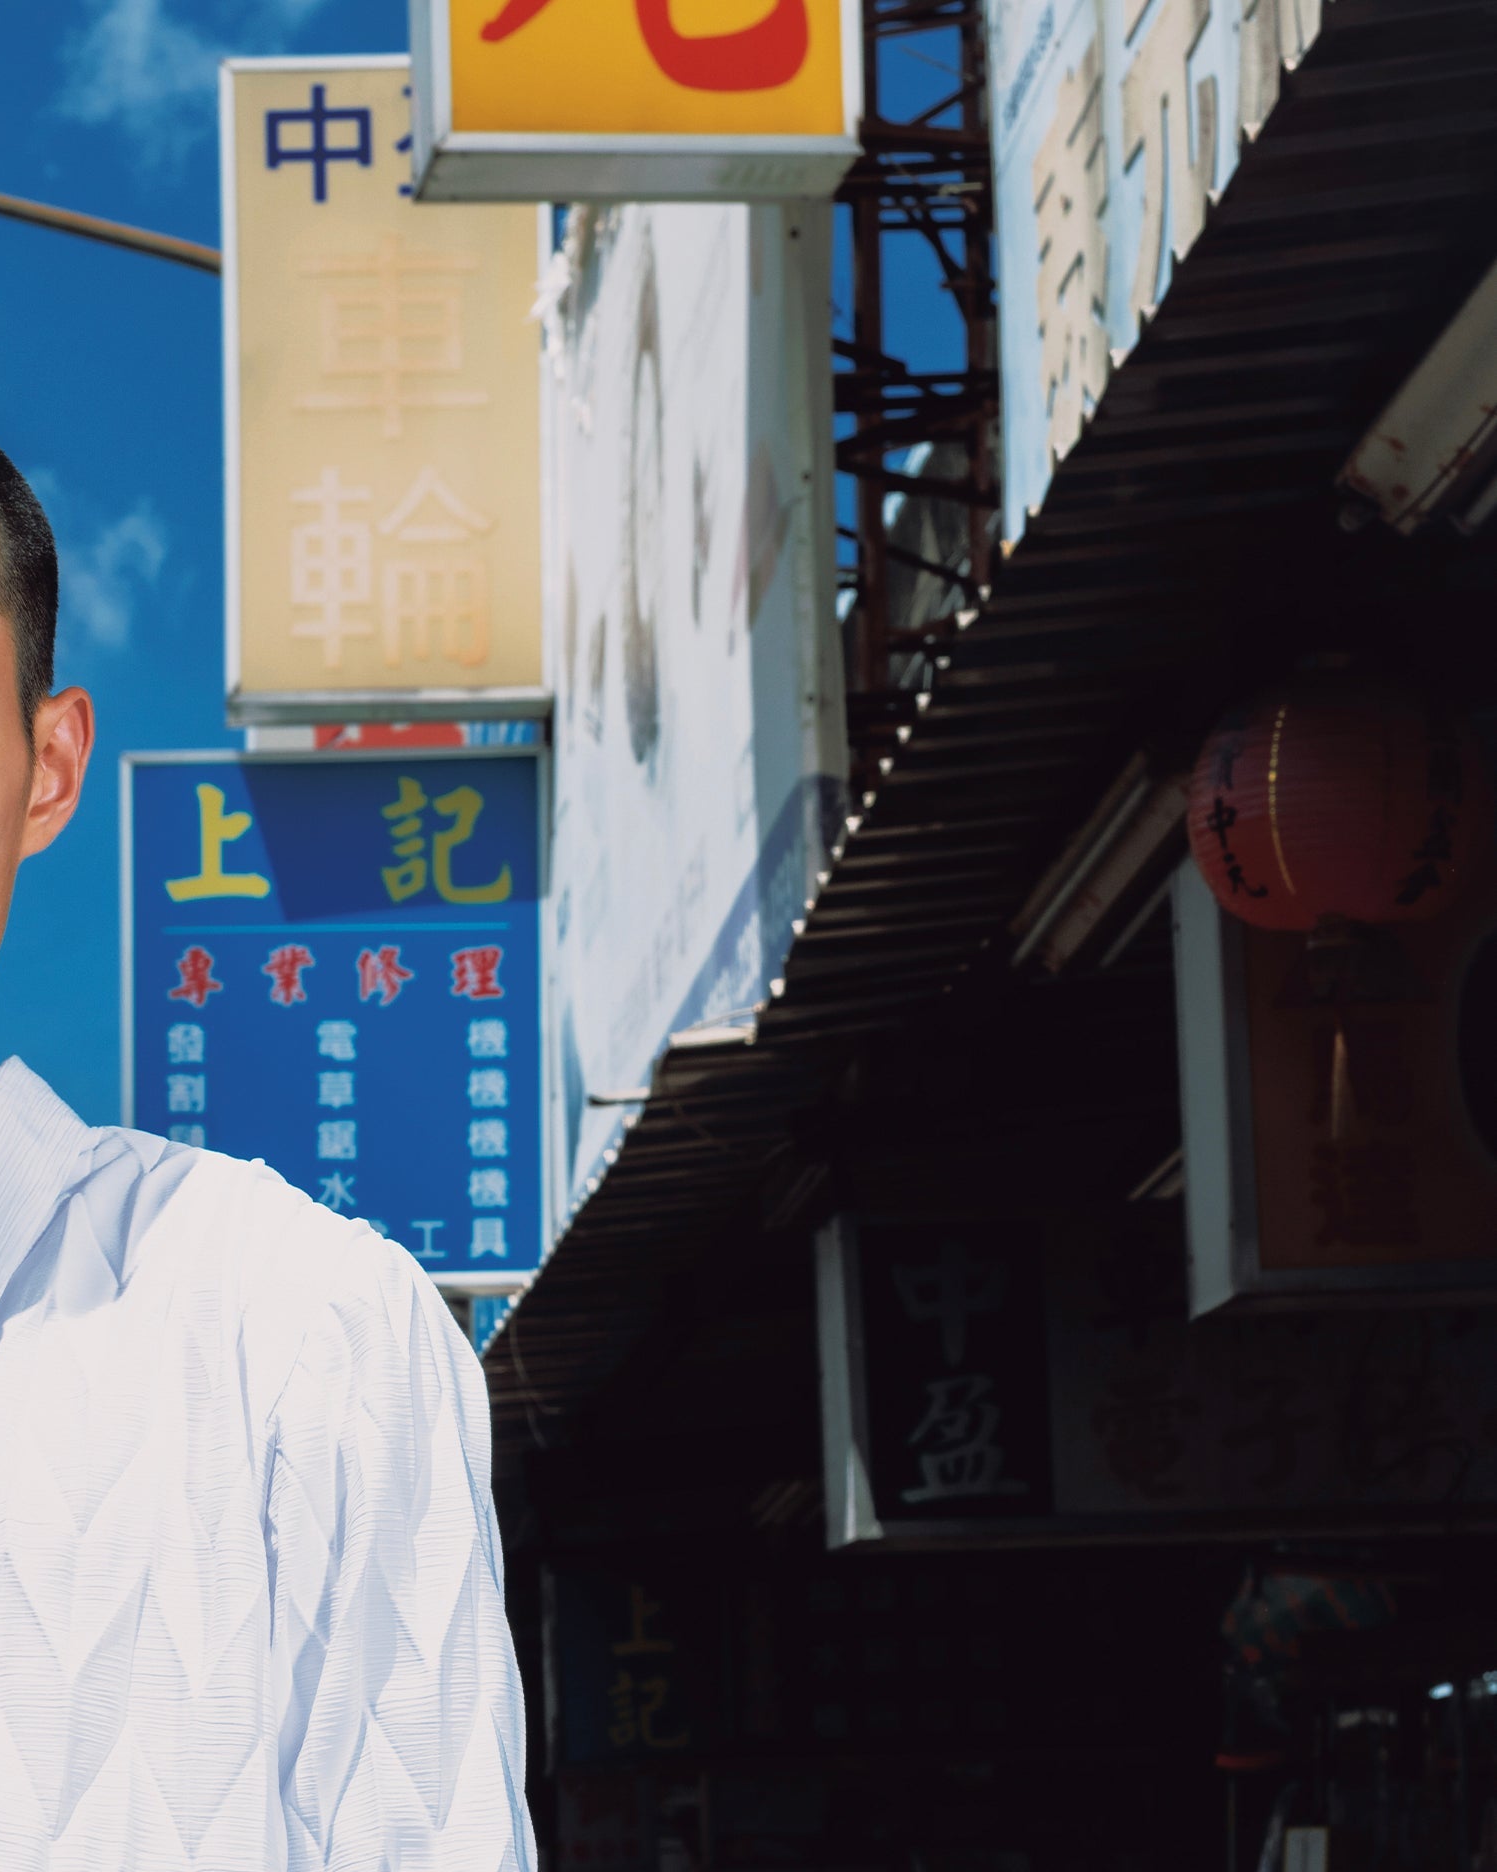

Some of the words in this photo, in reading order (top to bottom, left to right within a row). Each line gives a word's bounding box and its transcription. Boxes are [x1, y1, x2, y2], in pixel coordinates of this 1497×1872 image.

[265, 84, 413, 203] 中
[165, 776, 512, 904] 上記
[168, 945, 505, 1006] 專業修理
